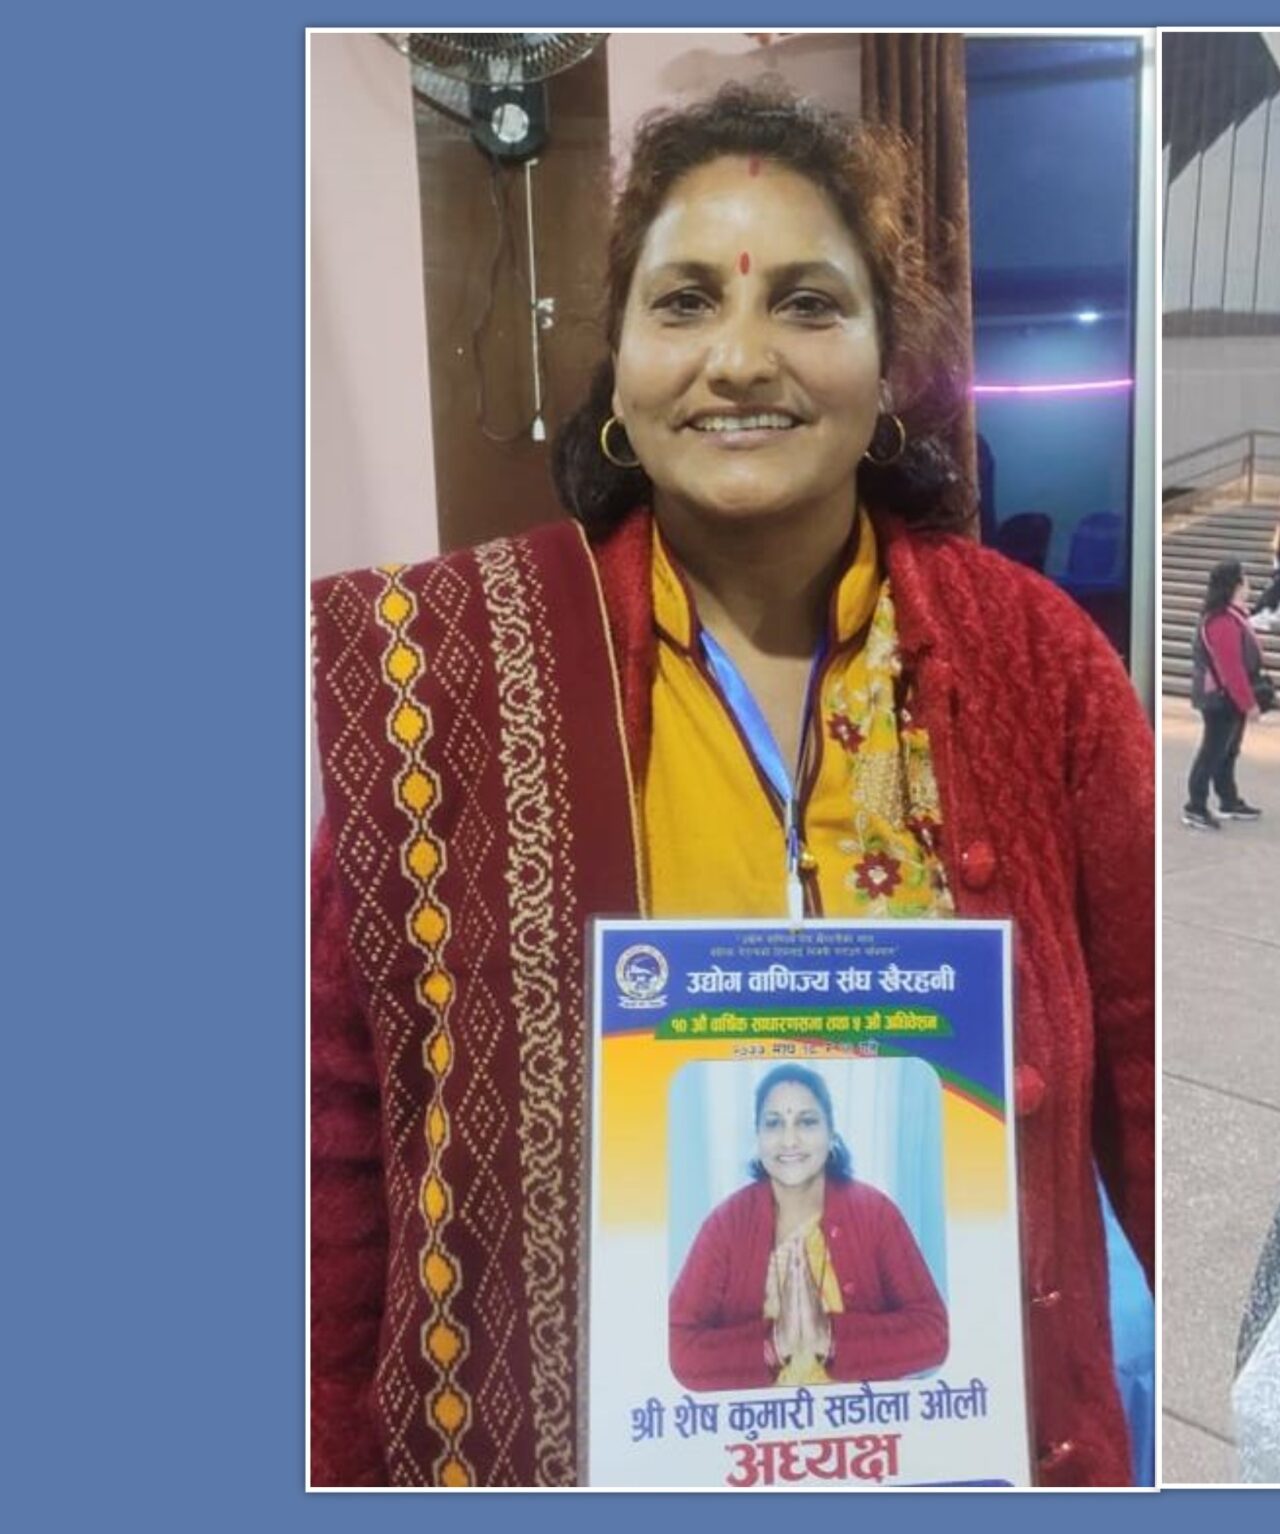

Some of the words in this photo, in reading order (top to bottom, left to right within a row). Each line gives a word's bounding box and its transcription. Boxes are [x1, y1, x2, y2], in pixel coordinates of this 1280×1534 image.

[686, 965, 742, 993] उद्योग
[748, 965, 830, 993] वाणिज्य
[836, 968, 872, 993] संघ
[878, 963, 956, 993] खैरहनी
[631, 1397, 665, 1442] श्री
[674, 1394, 719, 1439] शेष
[728, 1387, 814, 1440] कुमारी
[824, 1380, 909, 1427] सडौला
[920, 1377, 988, 1421] ओली
[724, 1433, 902, 1487] अध्यक्ष
